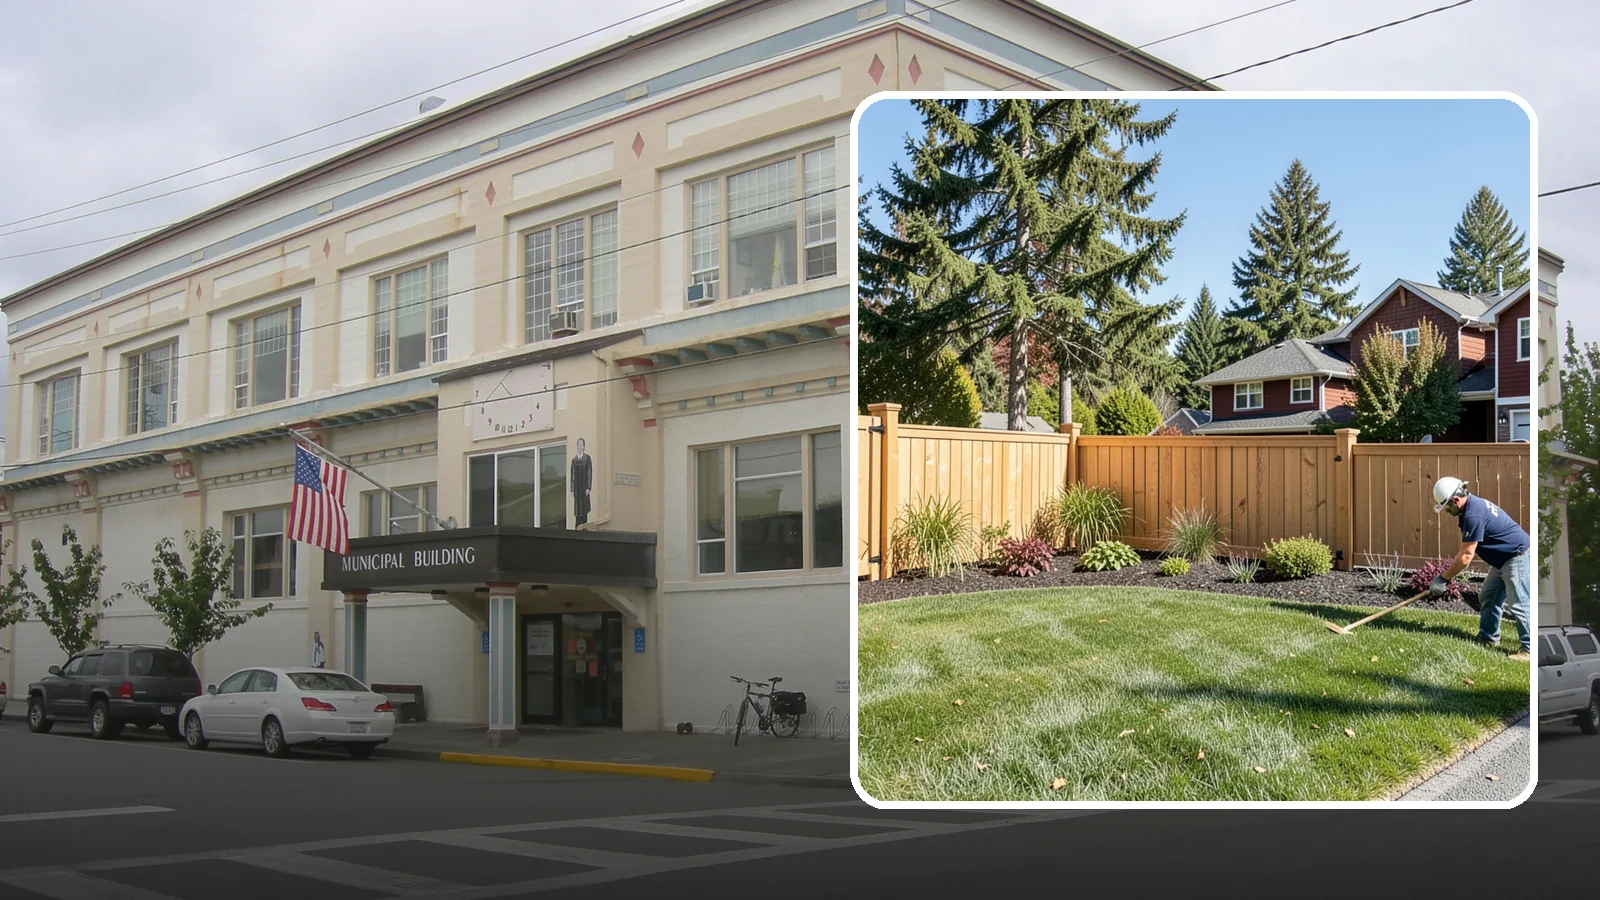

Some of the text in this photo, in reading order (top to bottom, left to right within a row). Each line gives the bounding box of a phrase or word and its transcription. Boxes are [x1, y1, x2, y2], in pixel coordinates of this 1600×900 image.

[475, 390, 479, 398] 7
[480, 407, 485, 415] 8
[487, 417, 492, 426] 9
[494, 423, 500, 432] 10
[501, 425, 506, 433] 11
[507, 425, 513, 433] 12
[521, 420, 525, 428] 2
[528, 414, 533, 422] 3
[536, 402, 540, 410] 4
[546, 361, 552, 370] 6
[342, 546, 475, 572] MUNICIPAL BUILDING
